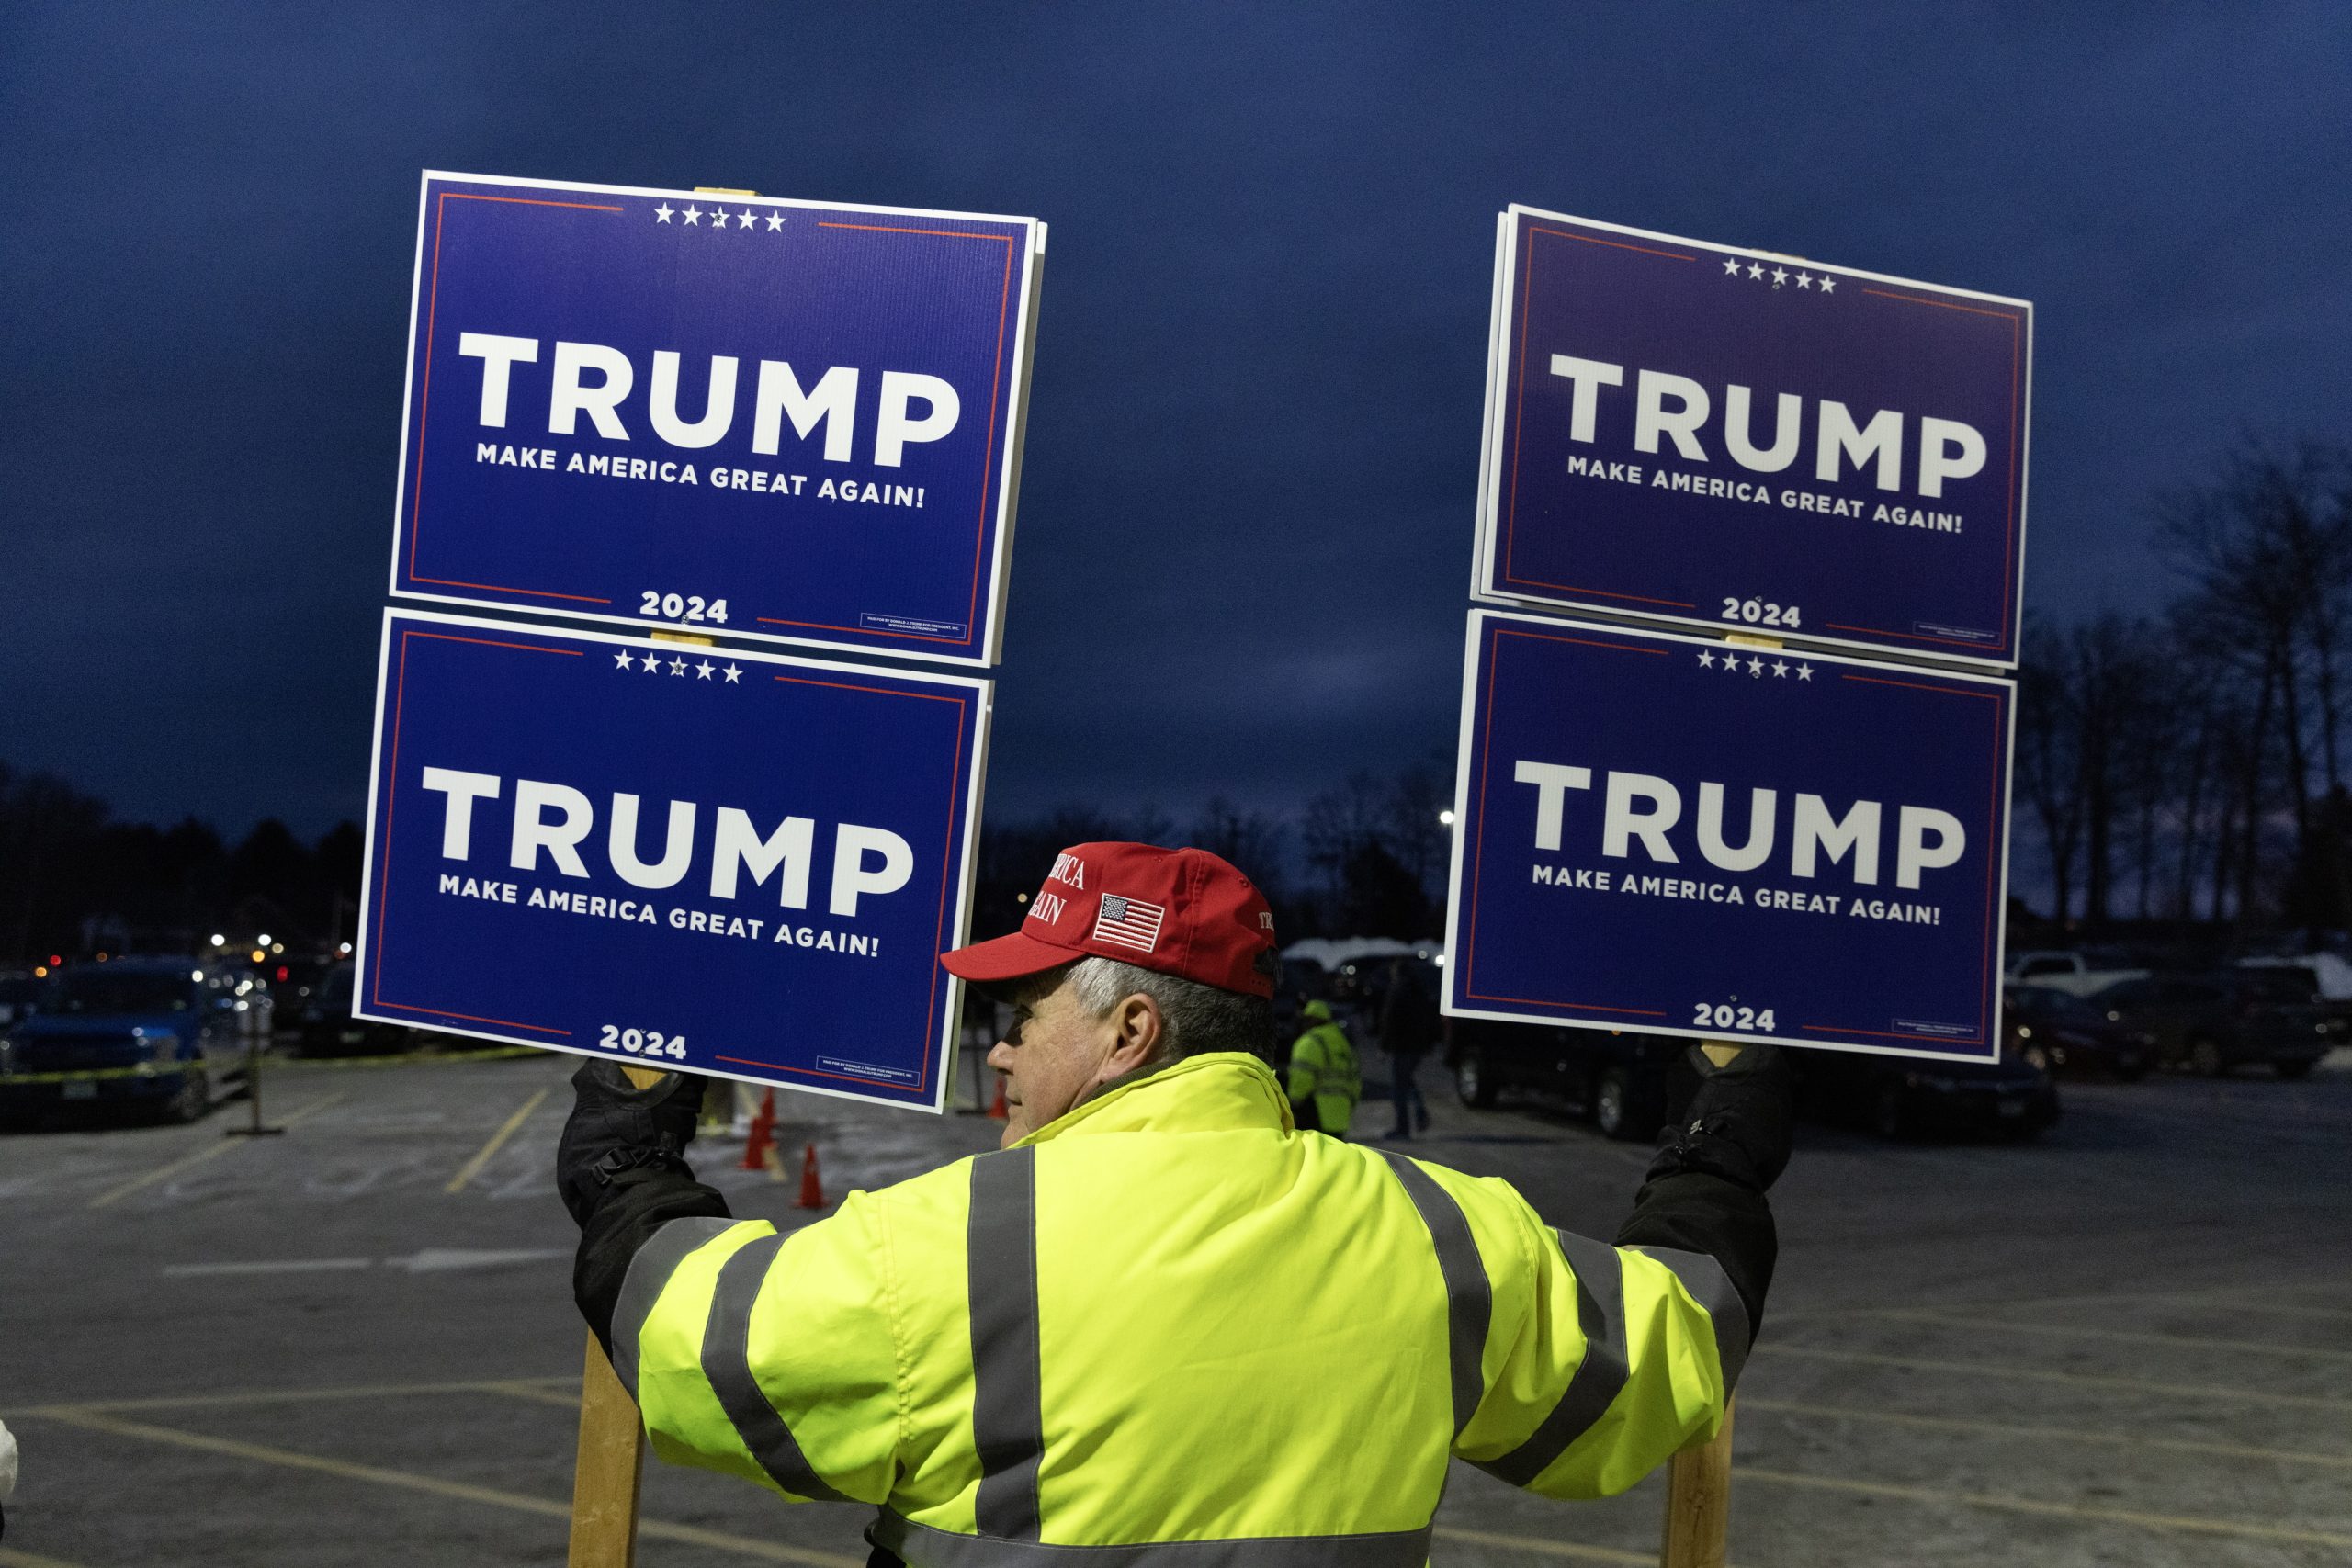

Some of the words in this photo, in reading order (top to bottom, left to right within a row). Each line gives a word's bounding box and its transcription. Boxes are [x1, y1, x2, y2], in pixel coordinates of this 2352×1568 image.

[459, 332, 960, 467] TRUMP
[1550, 354, 1986, 498] TRUMP
[476, 442, 557, 470] MAKE
[565, 452, 699, 485] AMERICA
[709, 467, 808, 496] GREAT
[817, 478, 925, 509] AGAIN!
[1567, 455, 1643, 485] MAKE
[1651, 469, 1771, 505] AMERICA
[1781, 490, 1865, 520] GREAT
[1872, 503, 1962, 534] AGAIN!
[639, 590, 729, 624] 2024
[1721, 597, 1801, 628] 2024
[423, 766, 913, 917] TRUMP
[1514, 761, 1965, 889] TRUMP
[439, 874, 518, 904] MAKE
[526, 887, 658, 925] AMERICA
[668, 908, 764, 940] GREAT
[773, 923, 879, 957] AGAIN!
[1532, 864, 1611, 891] MAKE
[1620, 874, 1744, 905] AMERICA
[1754, 888, 1841, 915] GREAT
[1849, 898, 1940, 926] AGAIN!
[599, 1024, 687, 1060] 2024
[1693, 1002, 1776, 1032] 2024
